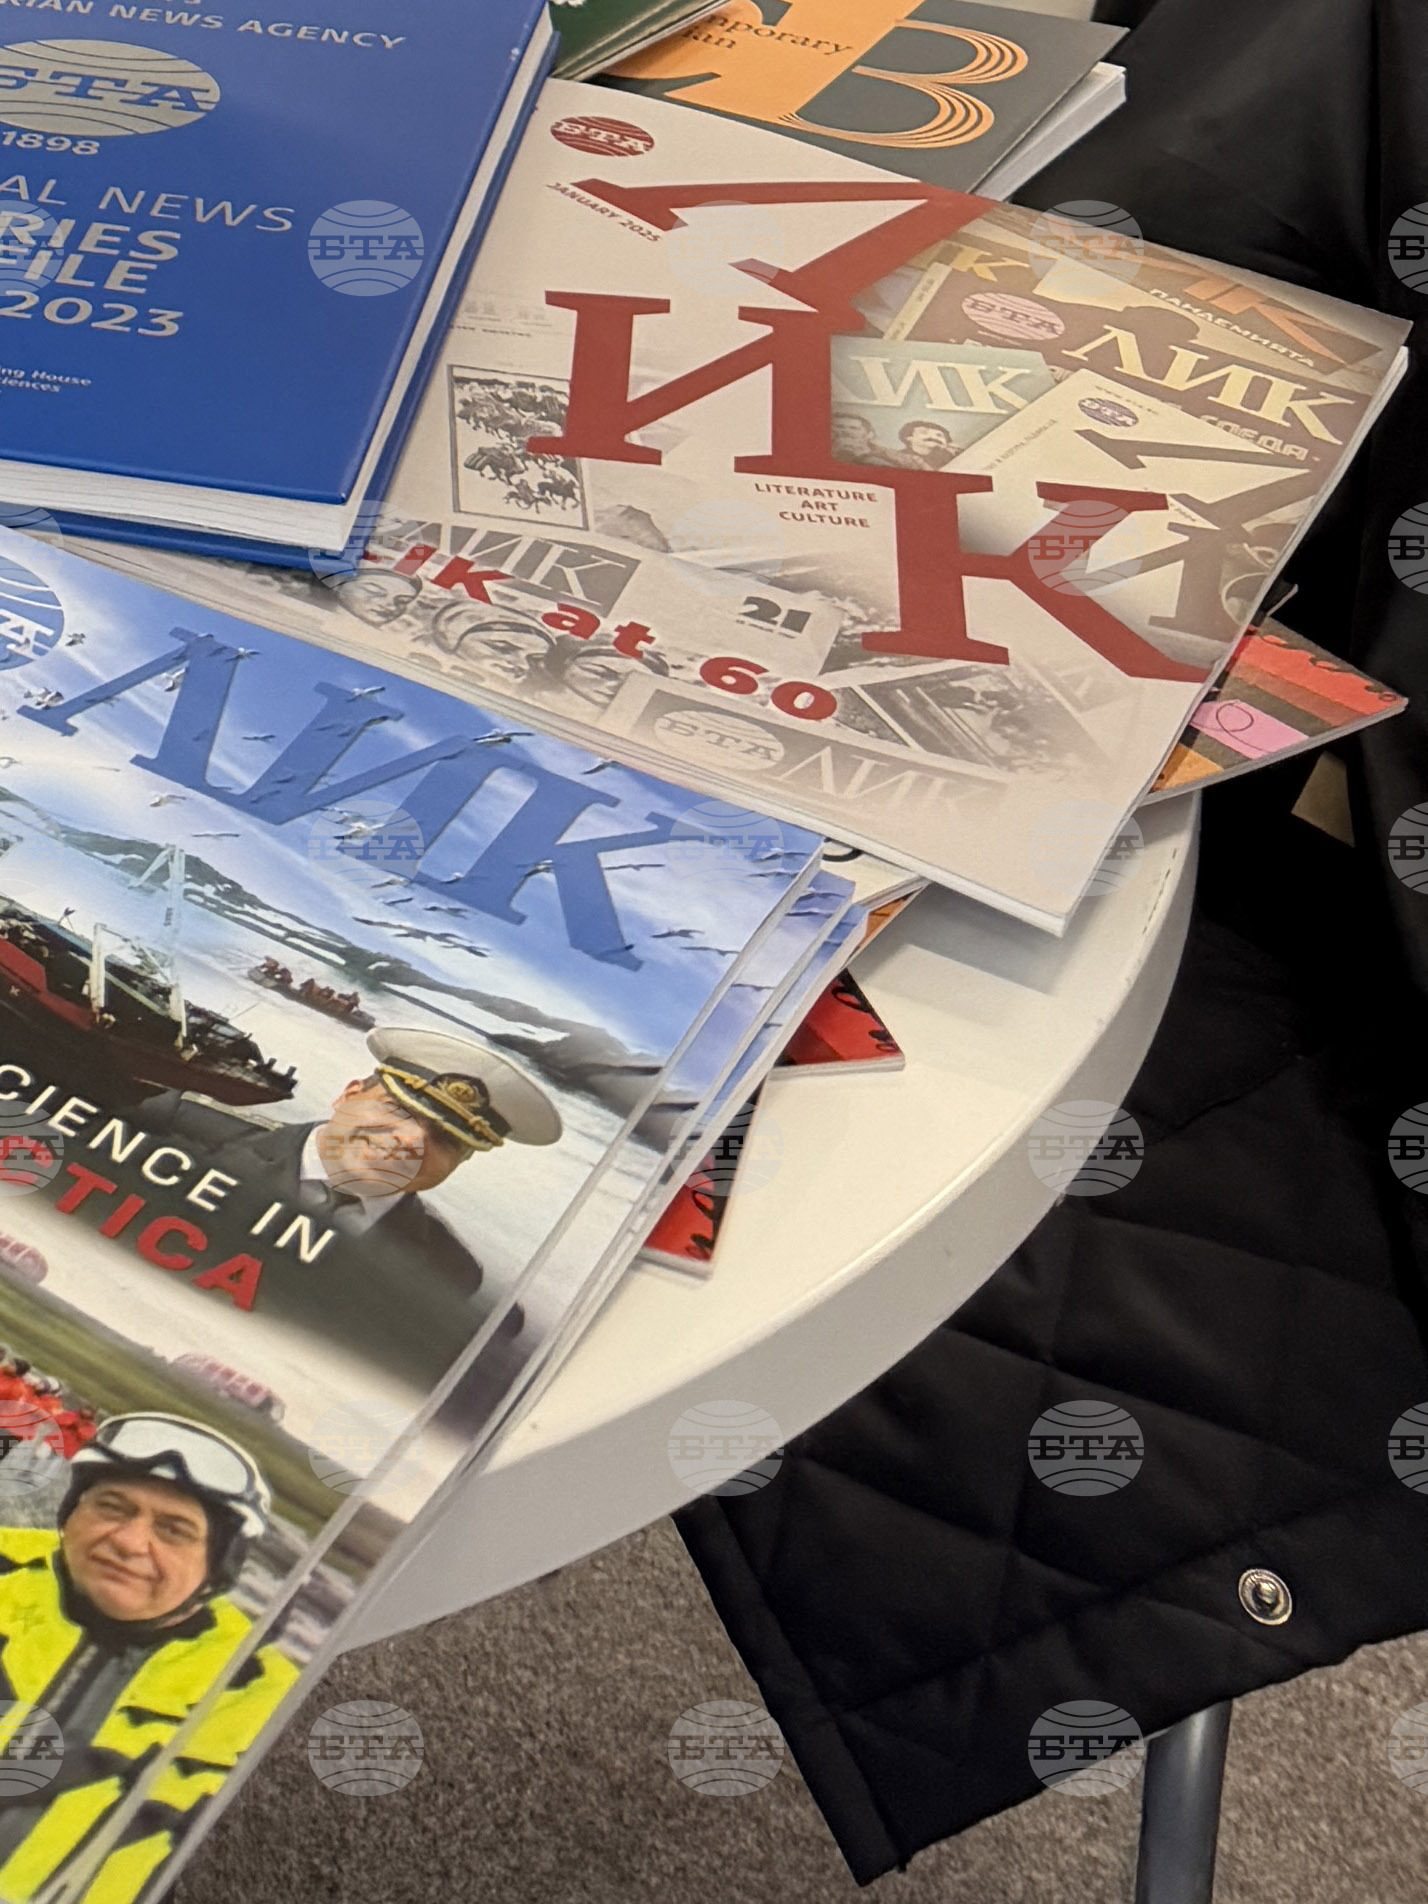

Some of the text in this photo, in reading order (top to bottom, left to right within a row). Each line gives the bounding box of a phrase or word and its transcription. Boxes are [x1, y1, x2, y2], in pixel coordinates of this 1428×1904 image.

[107, 2, 226, 31] NEWS
[235, 17, 408, 50] AGENCY
[0, 128, 101, 157] 1898
[96, 184, 298, 234] NEWS
[545, 180, 664, 243] JANUARY 2025
[30, 368, 93, 388] House
[1061, 323, 1356, 447] ЛИК
[753, 481, 880, 504] LITERATURE
[799, 498, 841, 515] ART
[778, 509, 872, 530] CULTURE
[541, 601, 838, 721] at 60
[17, 625, 700, 972] ЛИК
[252, 1201, 337, 1270] IN
